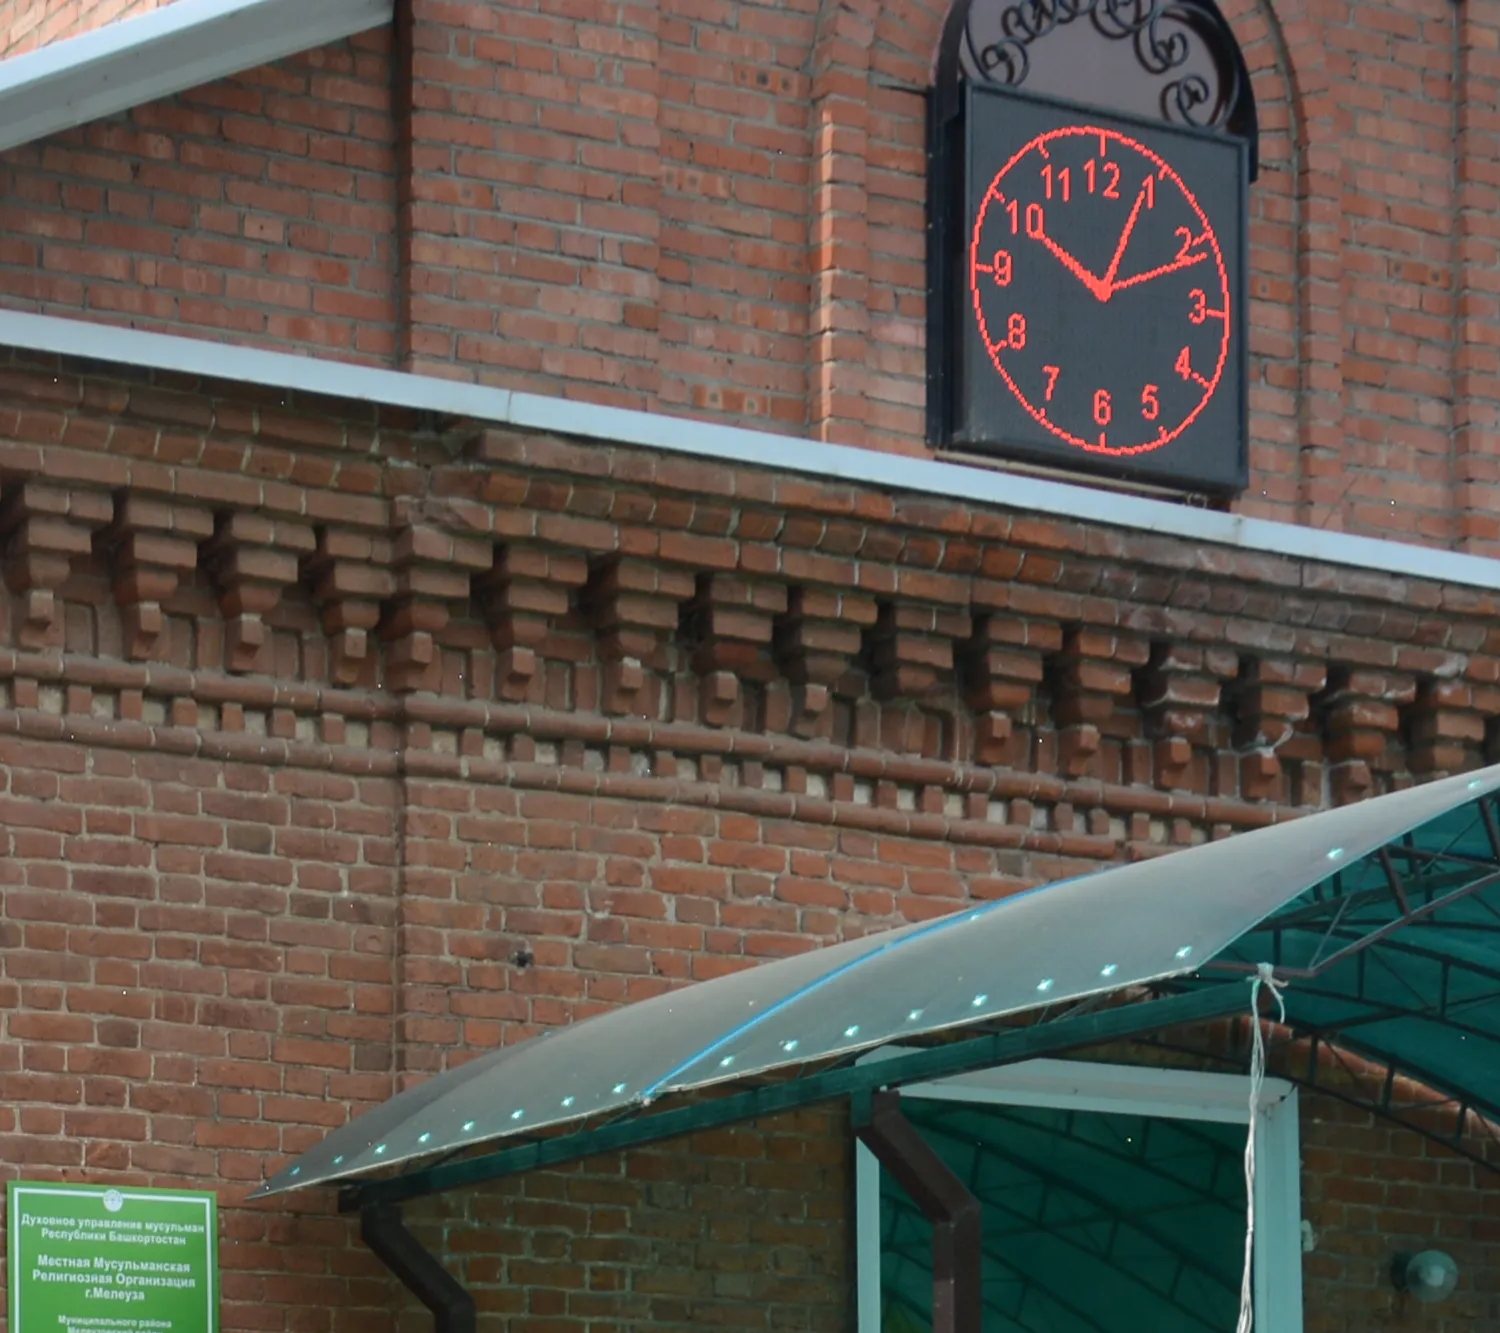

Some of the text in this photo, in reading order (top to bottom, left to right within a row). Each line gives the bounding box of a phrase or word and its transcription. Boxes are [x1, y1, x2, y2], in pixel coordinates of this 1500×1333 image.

[1041, 164, 1071, 202] 11
[1084, 160, 1120, 198] 12
[1142, 175, 1155, 209] 1
[1006, 199, 1044, 240] 10
[1175, 226, 1194, 262] 2
[994, 250, 1012, 285] 9
[1188, 289, 1206, 324] 3
[1008, 313, 1026, 350] 8
[1175, 346, 1191, 380] 4
[1042, 365, 1060, 400] 7
[1093, 389, 1111, 425] 6
[1141, 384, 1159, 420] 5
[21, 1213, 204, 1233] Духовное управление мусульман
[41, 1228, 186, 1245] Республики Башкортостан
[32, 1269, 112, 1284] Религиозная
[38, 1254, 190, 1273] Местная Мусульманская
[85, 1287, 145, 1302] г.Мелеуза
[58, 1315, 172, 1329] Муниципального района
